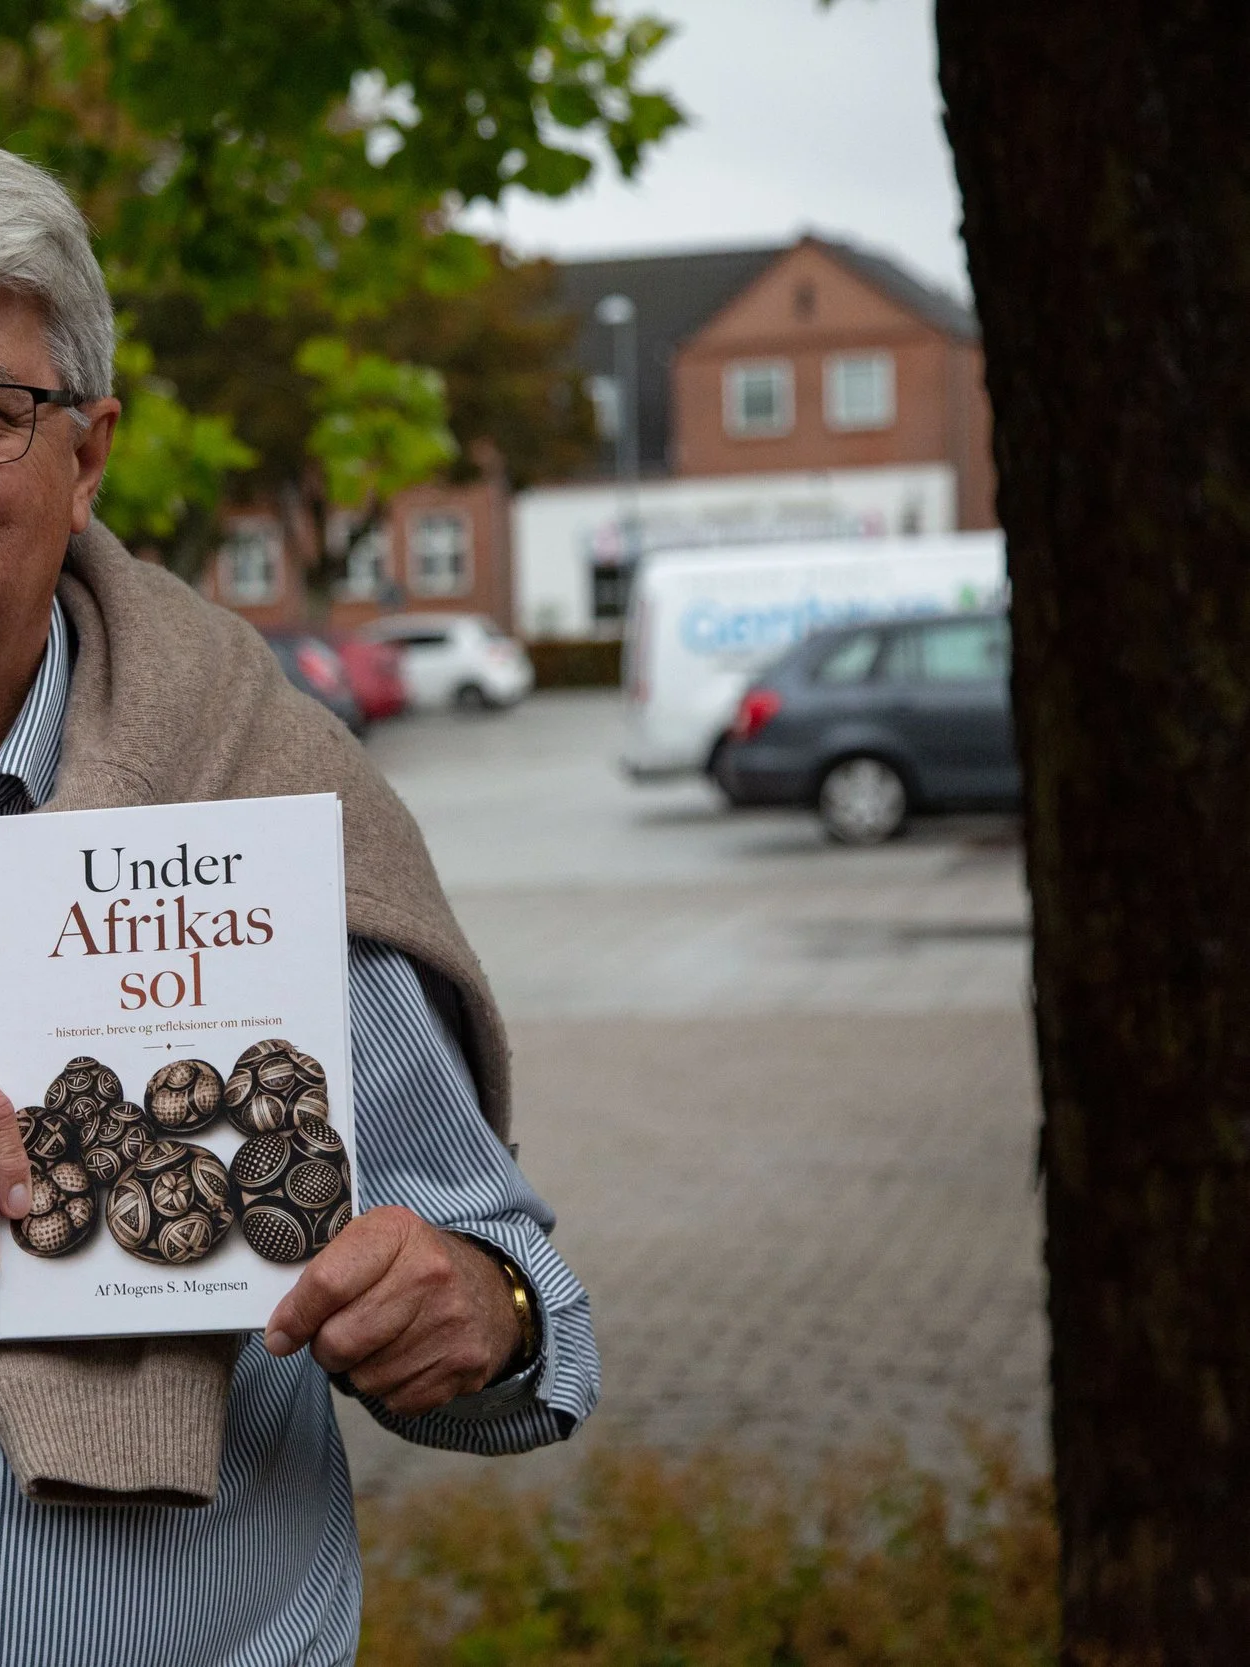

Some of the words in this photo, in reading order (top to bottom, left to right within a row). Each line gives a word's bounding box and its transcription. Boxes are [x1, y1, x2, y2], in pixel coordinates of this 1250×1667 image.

[79, 842, 243, 893] Under
[47, 894, 274, 958] Afrikas
[120, 951, 207, 1011] sol
[55, 1025, 104, 1038] historier,
[106, 1023, 137, 1035] breve
[138, 1025, 153, 1036] og
[155, 1018, 219, 1032] refleksioner
[220, 1019, 238, 1028] om
[240, 1015, 282, 1026] mission
[94, 1283, 112, 1297] Af
[113, 1282, 164, 1298] Mogens
[166, 1281, 180, 1294] S.
[183, 1279, 249, 1296] Mogensen
